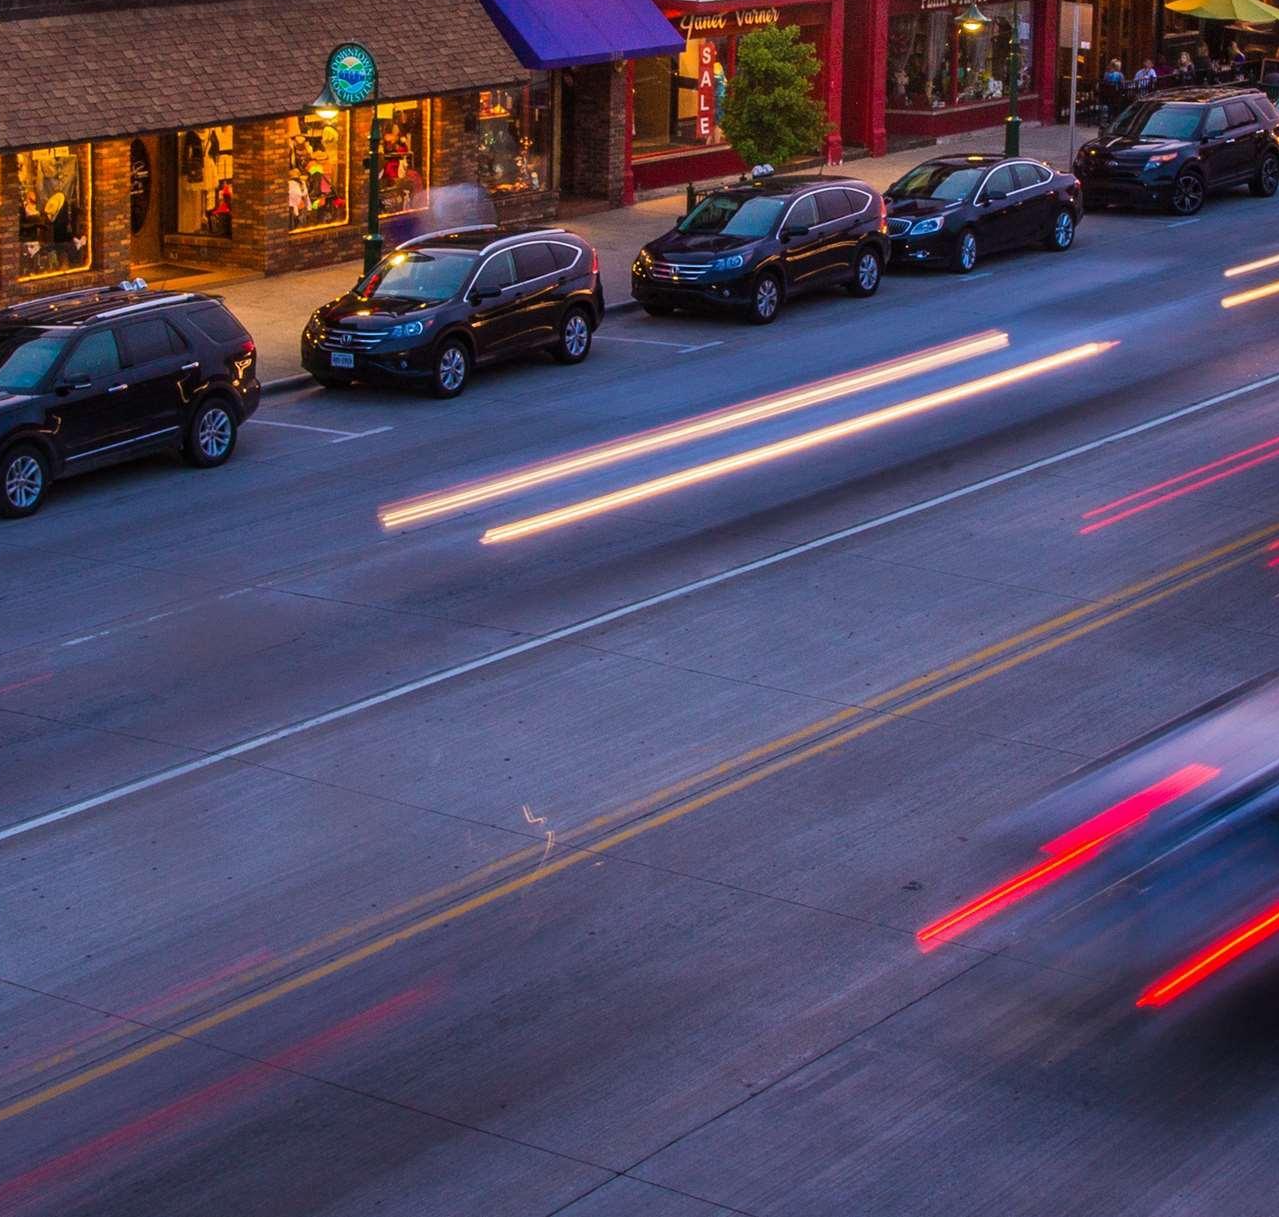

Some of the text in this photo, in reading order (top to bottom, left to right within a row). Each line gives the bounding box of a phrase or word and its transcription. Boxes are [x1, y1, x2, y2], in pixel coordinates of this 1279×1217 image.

[680, 6, 780, 41] Janet Varner
[701, 47, 712, 135] SALE
